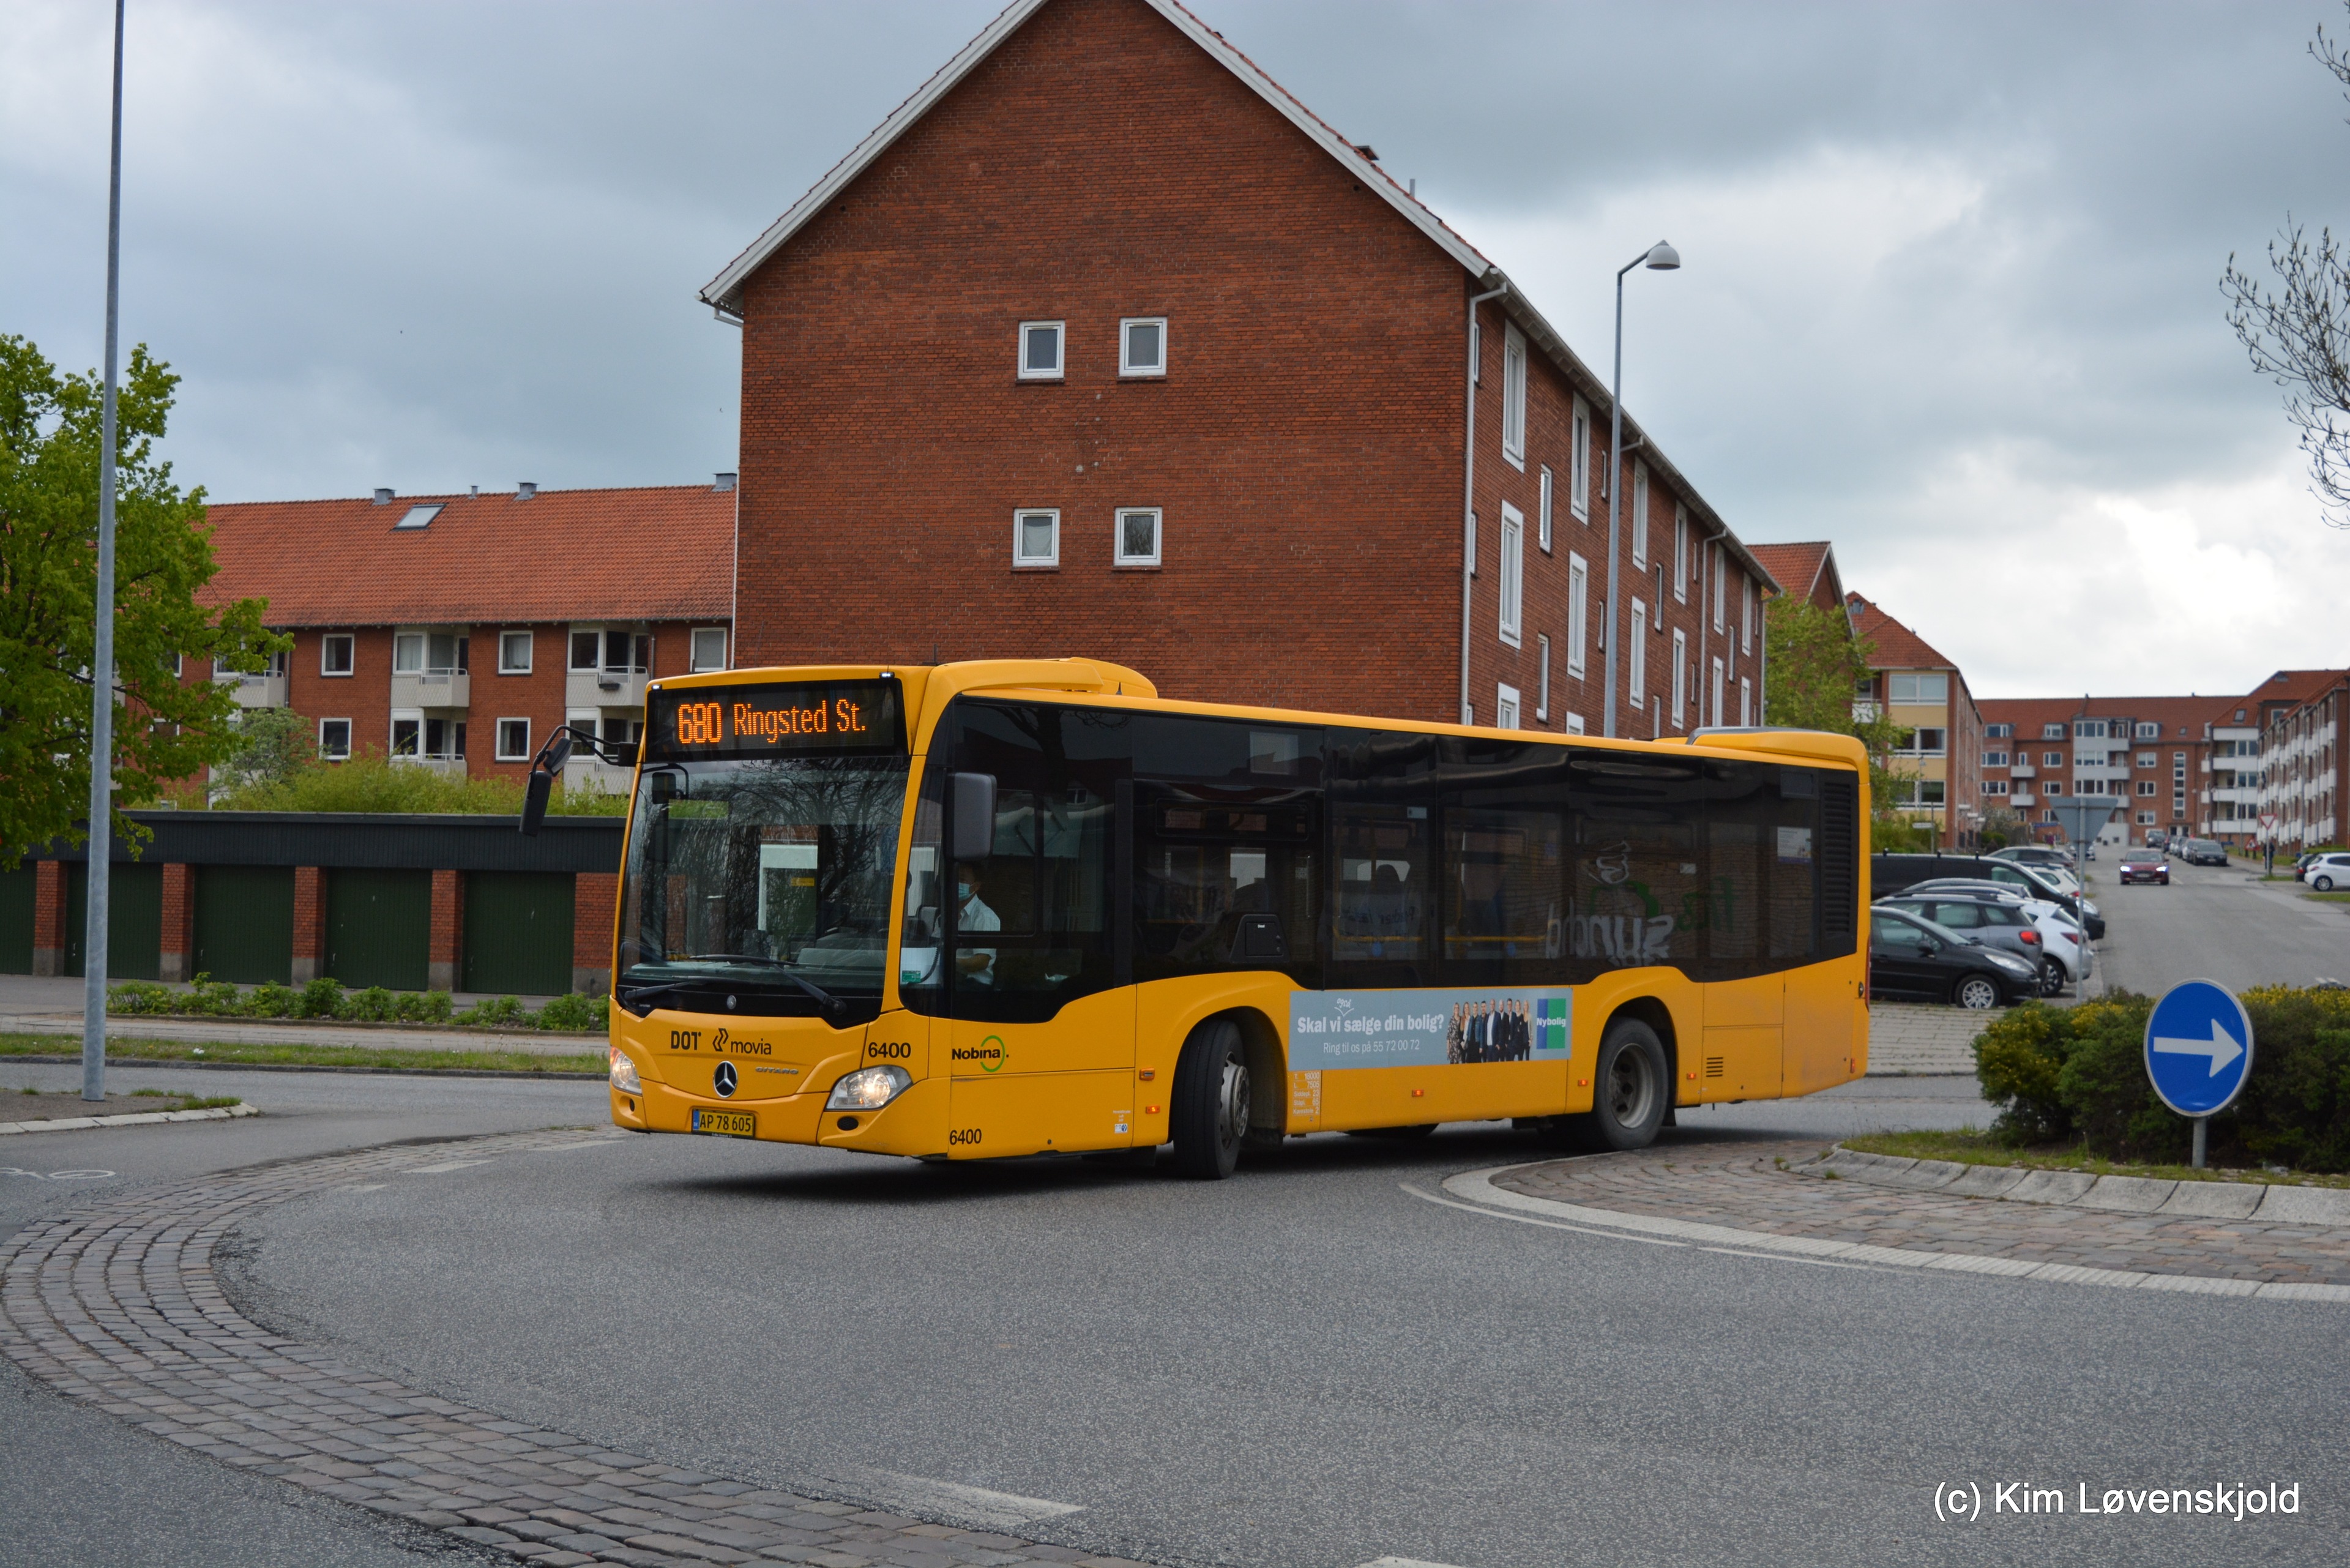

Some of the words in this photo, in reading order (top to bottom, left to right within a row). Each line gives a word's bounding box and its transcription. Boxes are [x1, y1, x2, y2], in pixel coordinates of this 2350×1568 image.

[679, 703, 722, 744] 680
[734, 700, 827, 744] Ringsted
[837, 699, 866, 731] St.
[1337, 998, 1352, 1009] også
[1297, 1017, 1327, 1033] Skal
[1330, 1016, 1341, 1032] vi
[1344, 1016, 1382, 1035] sælge
[1384, 1015, 1404, 1031] din
[1408, 1014, 1444, 1033] bolig?
[1536, 1017, 1567, 1028] Nybolig
[671, 1031, 701, 1050] DOT
[731, 1038, 772, 1055] movia
[1323, 1042, 1340, 1056] Ring
[1351, 1043, 1360, 1053] os
[1362, 1040, 1371, 1054] på
[1373, 1041, 1383, 1052] 55
[1386, 1040, 1396, 1051] 72
[1397, 1040, 1408, 1051] 00
[1410, 1039, 1420, 1050] 72
[868, 1042, 911, 1059] 6400
[755, 1066, 799, 1075] CITARO
[699, 1114, 714, 1129] AP
[717, 1115, 729, 1130] 78
[732, 1116, 752, 1132] 605
[949, 1129, 982, 1145] 6400
